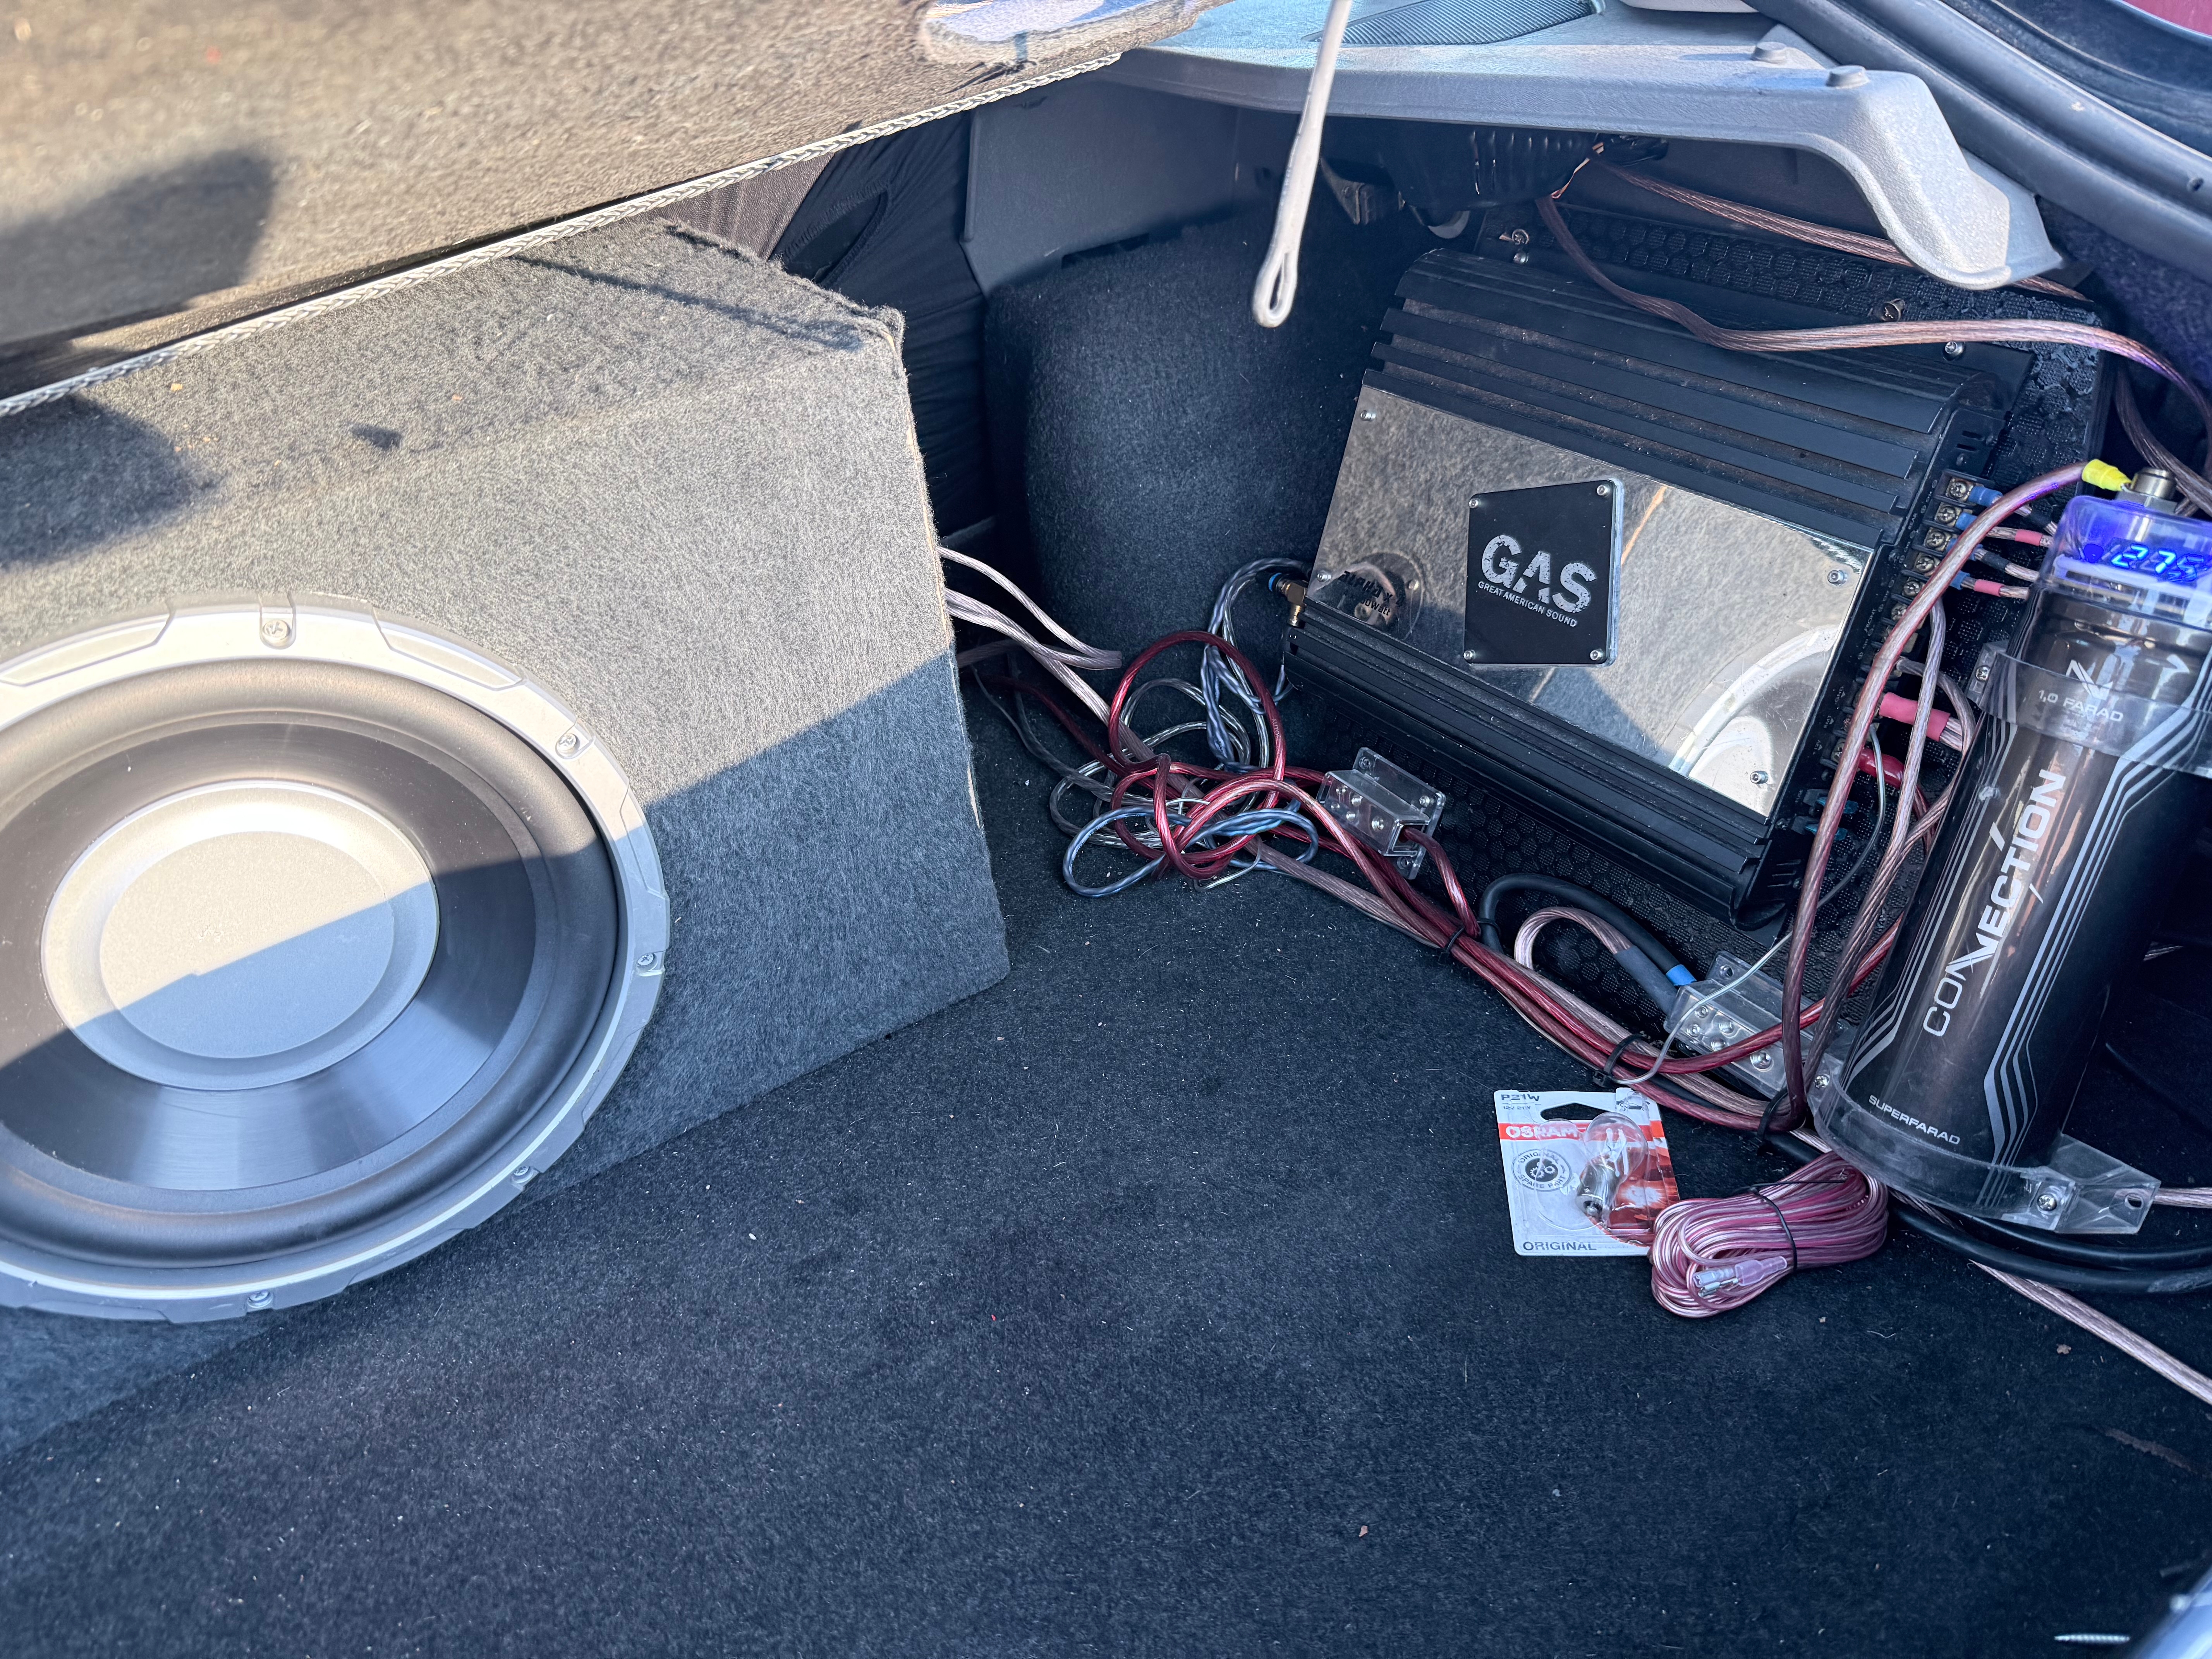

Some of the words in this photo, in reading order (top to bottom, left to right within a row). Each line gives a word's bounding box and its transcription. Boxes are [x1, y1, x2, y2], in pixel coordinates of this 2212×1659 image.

[1482, 534, 1596, 613] GAS
[1478, 581, 1505, 596] GREAT
[1503, 592, 1546, 614] AMERICAN
[1546, 609, 1578, 627] SOUND
[2063, 697, 2124, 722] FARAD
[1501, 1093, 1540, 1101] P21W
[1869, 1095, 1960, 1145] SUPERFARAD
[1505, 1126, 1577, 1138] OSRAM
[1518, 1174, 1545, 1188] SPARE
[1547, 1175, 1566, 1188] PART
[1523, 1241, 1597, 1251] ORIGINAL
